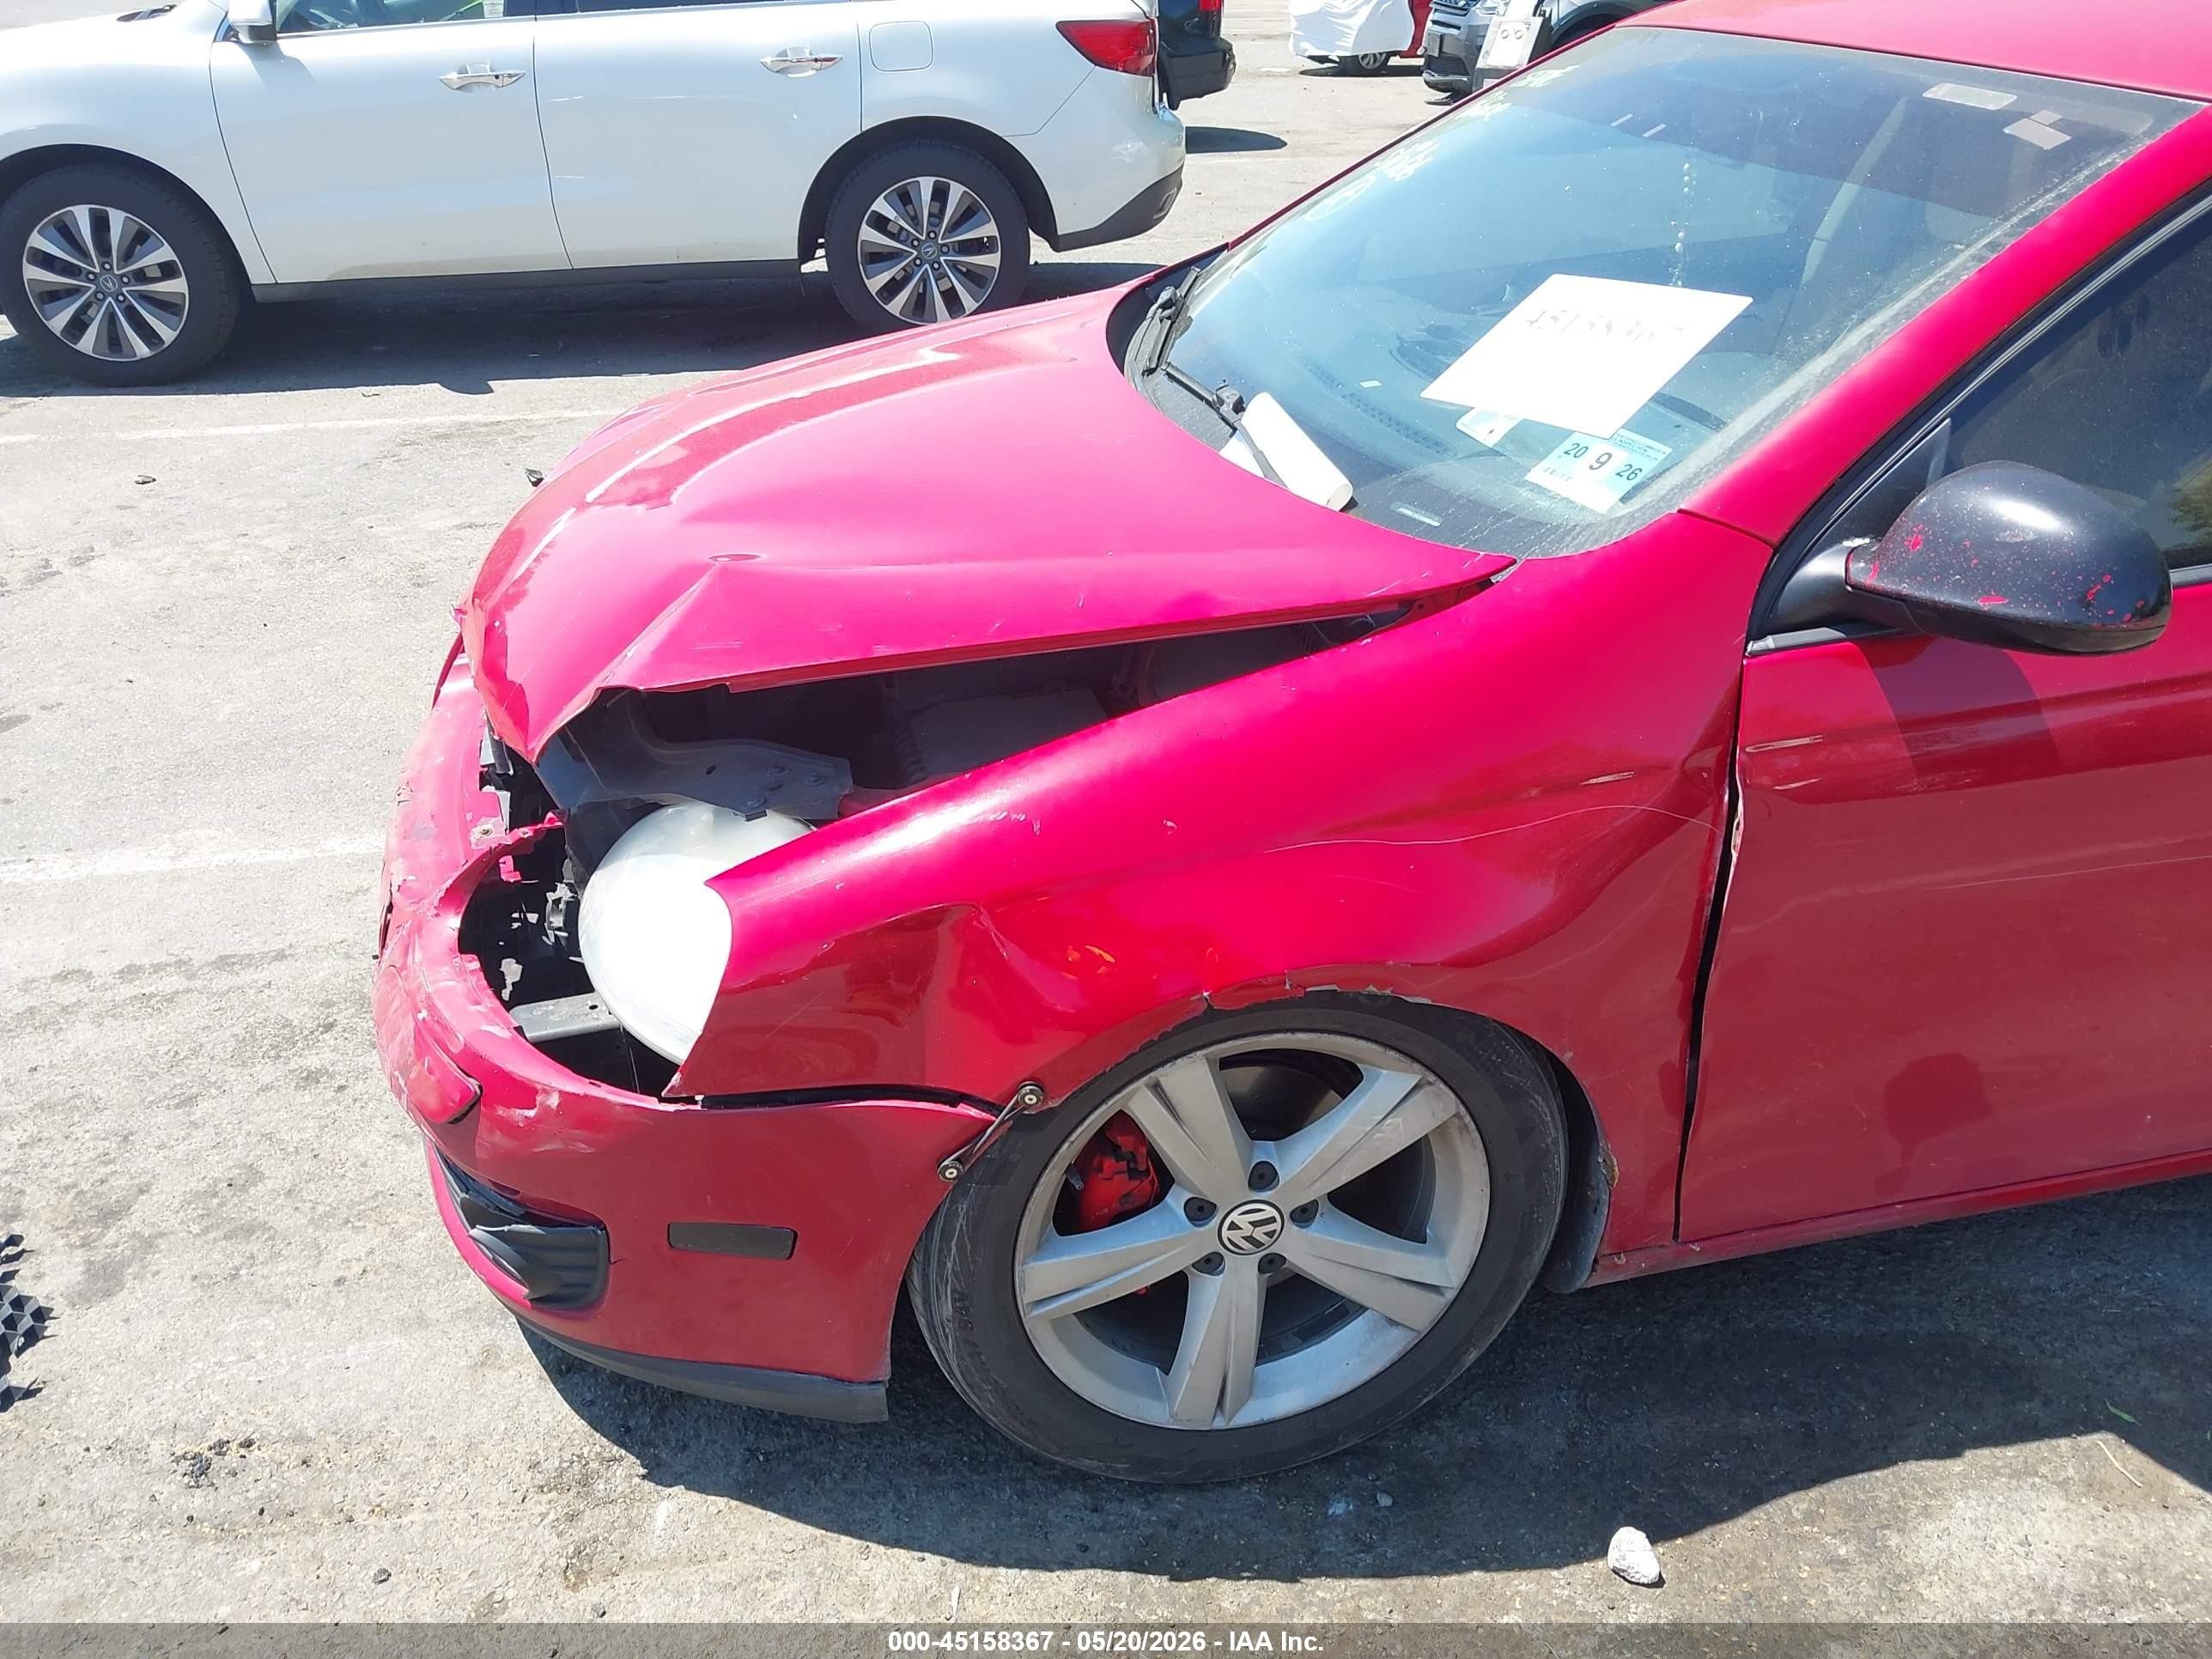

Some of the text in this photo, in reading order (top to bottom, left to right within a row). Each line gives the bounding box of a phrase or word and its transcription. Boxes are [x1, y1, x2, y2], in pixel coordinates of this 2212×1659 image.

[1563, 442, 1589, 459] 20
[1589, 452, 1613, 471] 9
[1615, 464, 1643, 481] 26
